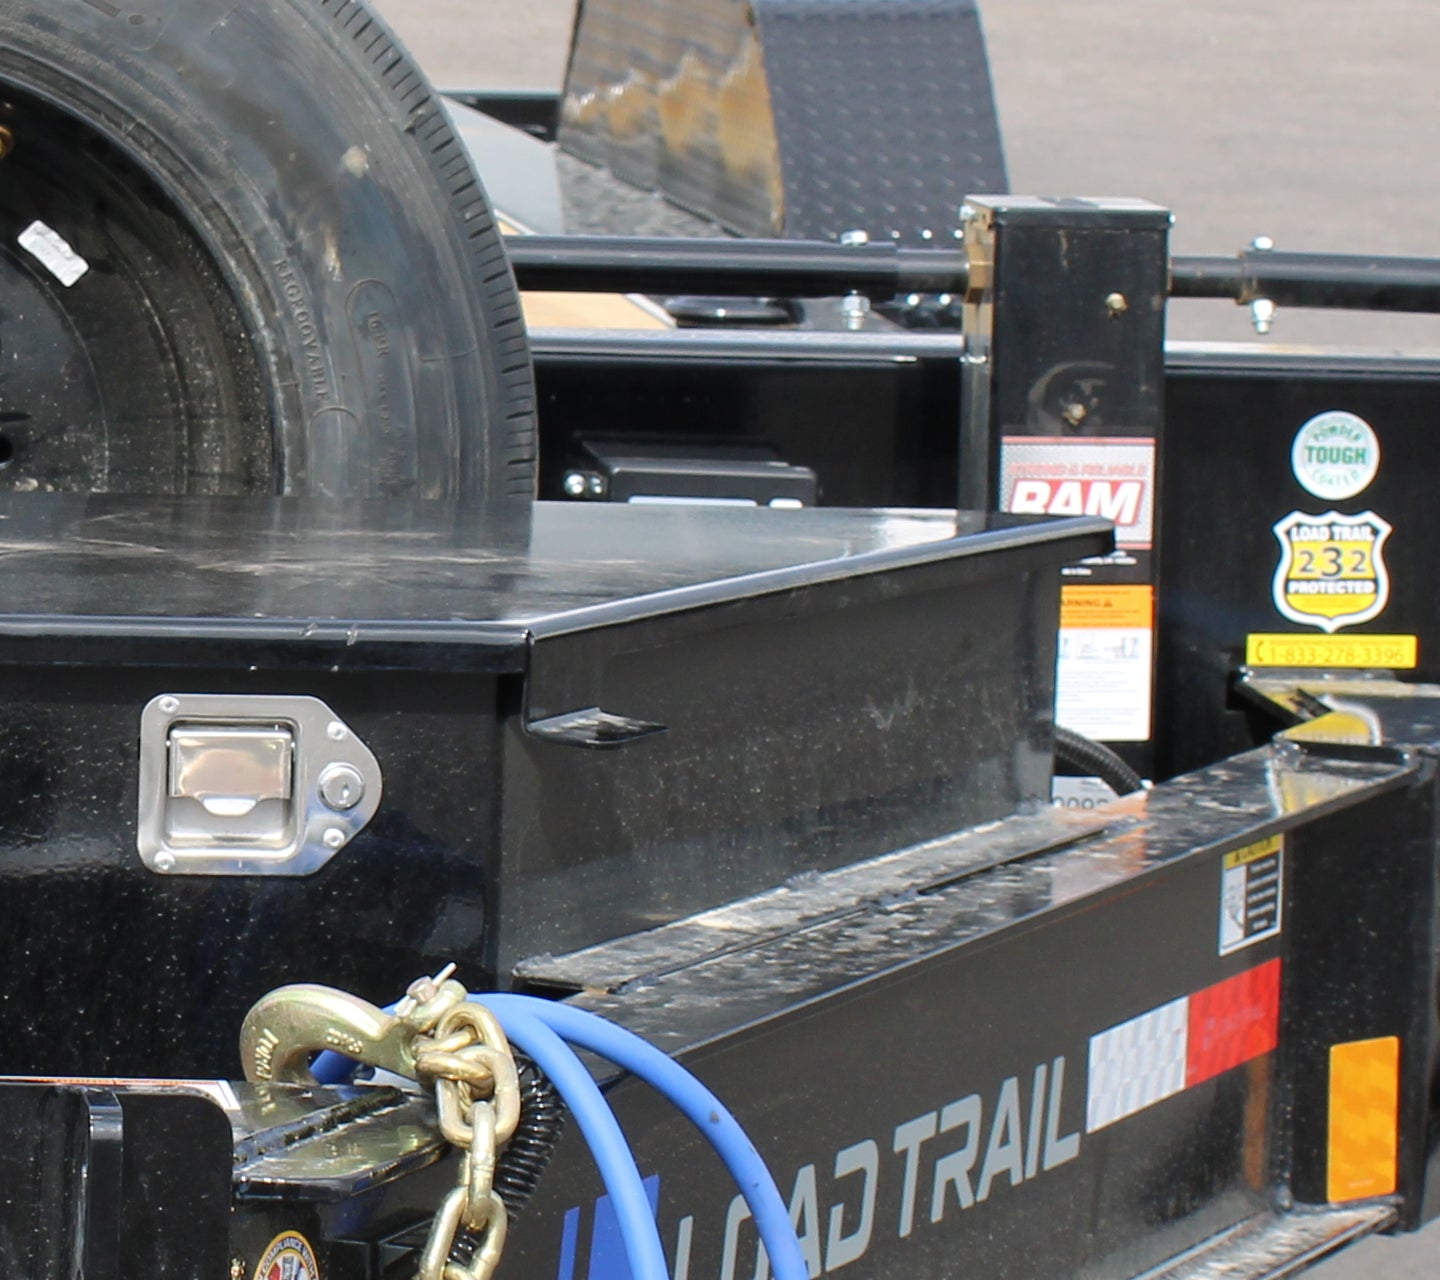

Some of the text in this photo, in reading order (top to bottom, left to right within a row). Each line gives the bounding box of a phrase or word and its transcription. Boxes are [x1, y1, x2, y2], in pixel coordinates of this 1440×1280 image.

[1305, 446, 1367, 465] TOUGH
[1011, 480, 1142, 524] RAM
[1289, 525, 1375, 541] LOAD TRAIL
[1288, 581, 1376, 595] PROTECTED
[1061, 599, 1101, 608] ARNING
[1270, 646, 1405, 664] 1-833-278-3396
[893, 1056, 1081, 1239] TRAIL
[261, 1237, 302, 1272] COMPLIANCE
